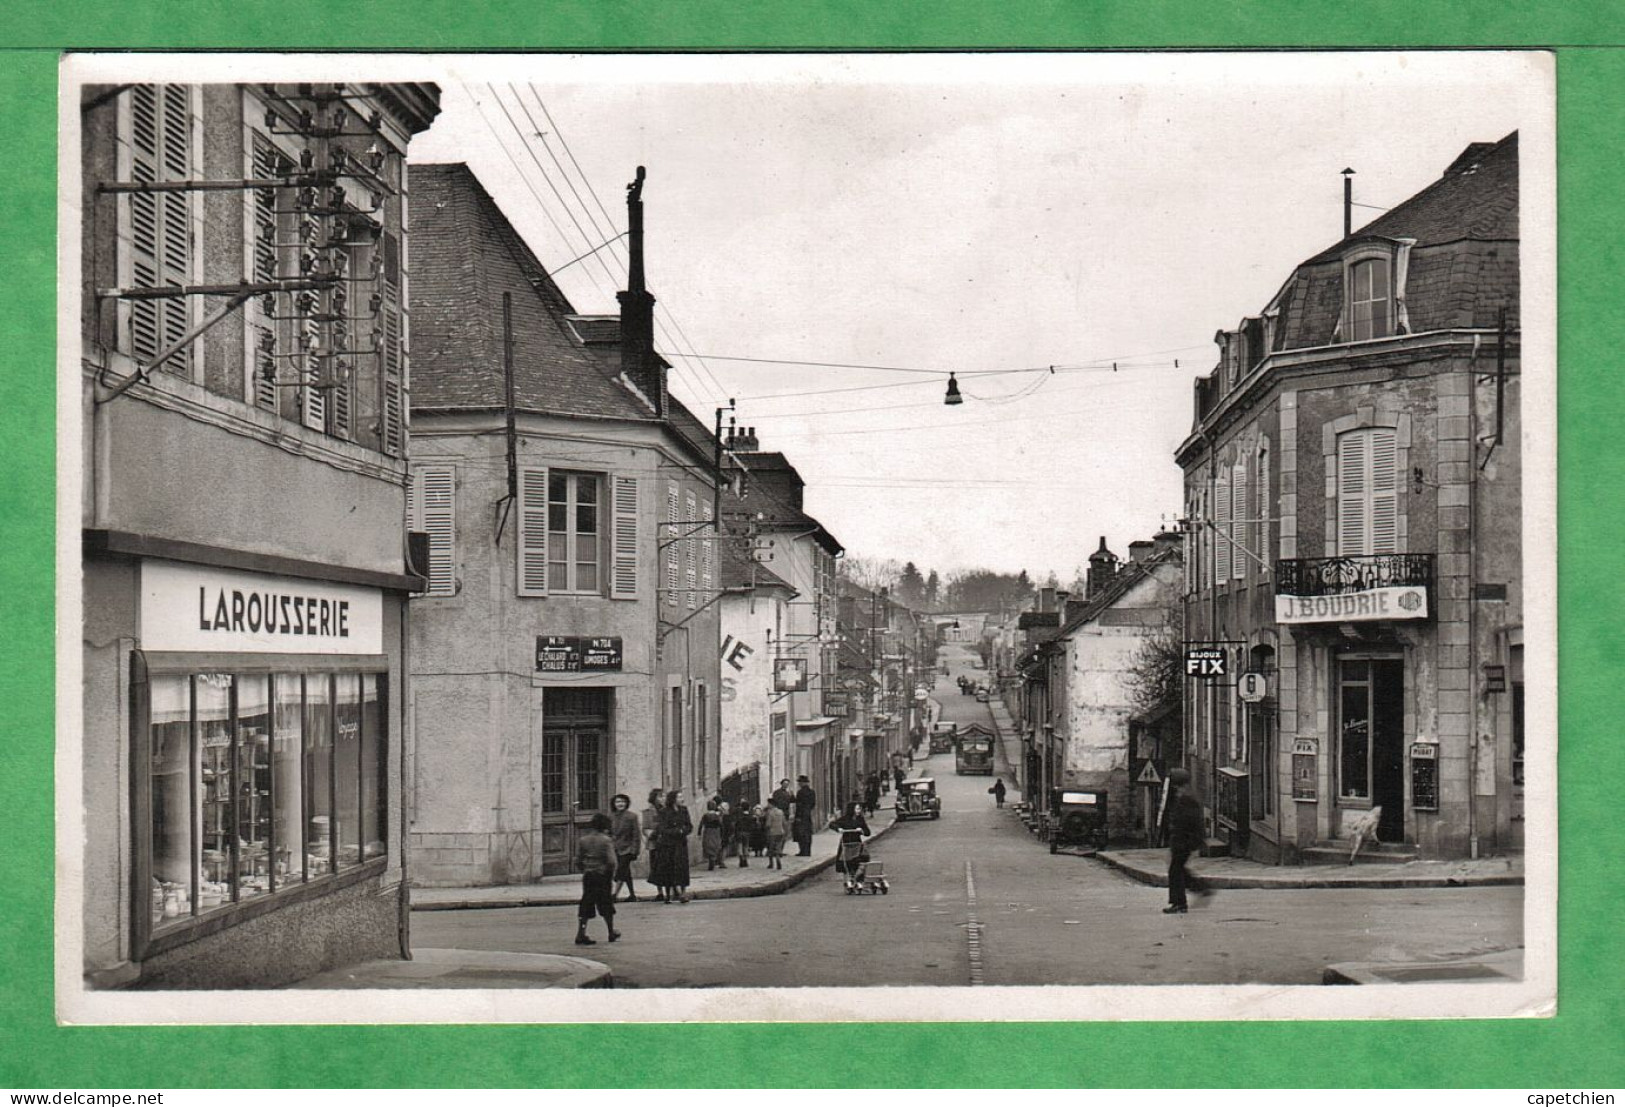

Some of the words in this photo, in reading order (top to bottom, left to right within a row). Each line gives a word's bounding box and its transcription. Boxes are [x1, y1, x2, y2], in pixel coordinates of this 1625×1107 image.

[199, 586, 349, 637] LAROUSSERIE
[1189, 651, 1222, 659] BIJOUX
[1187, 660, 1225, 675] FIX
